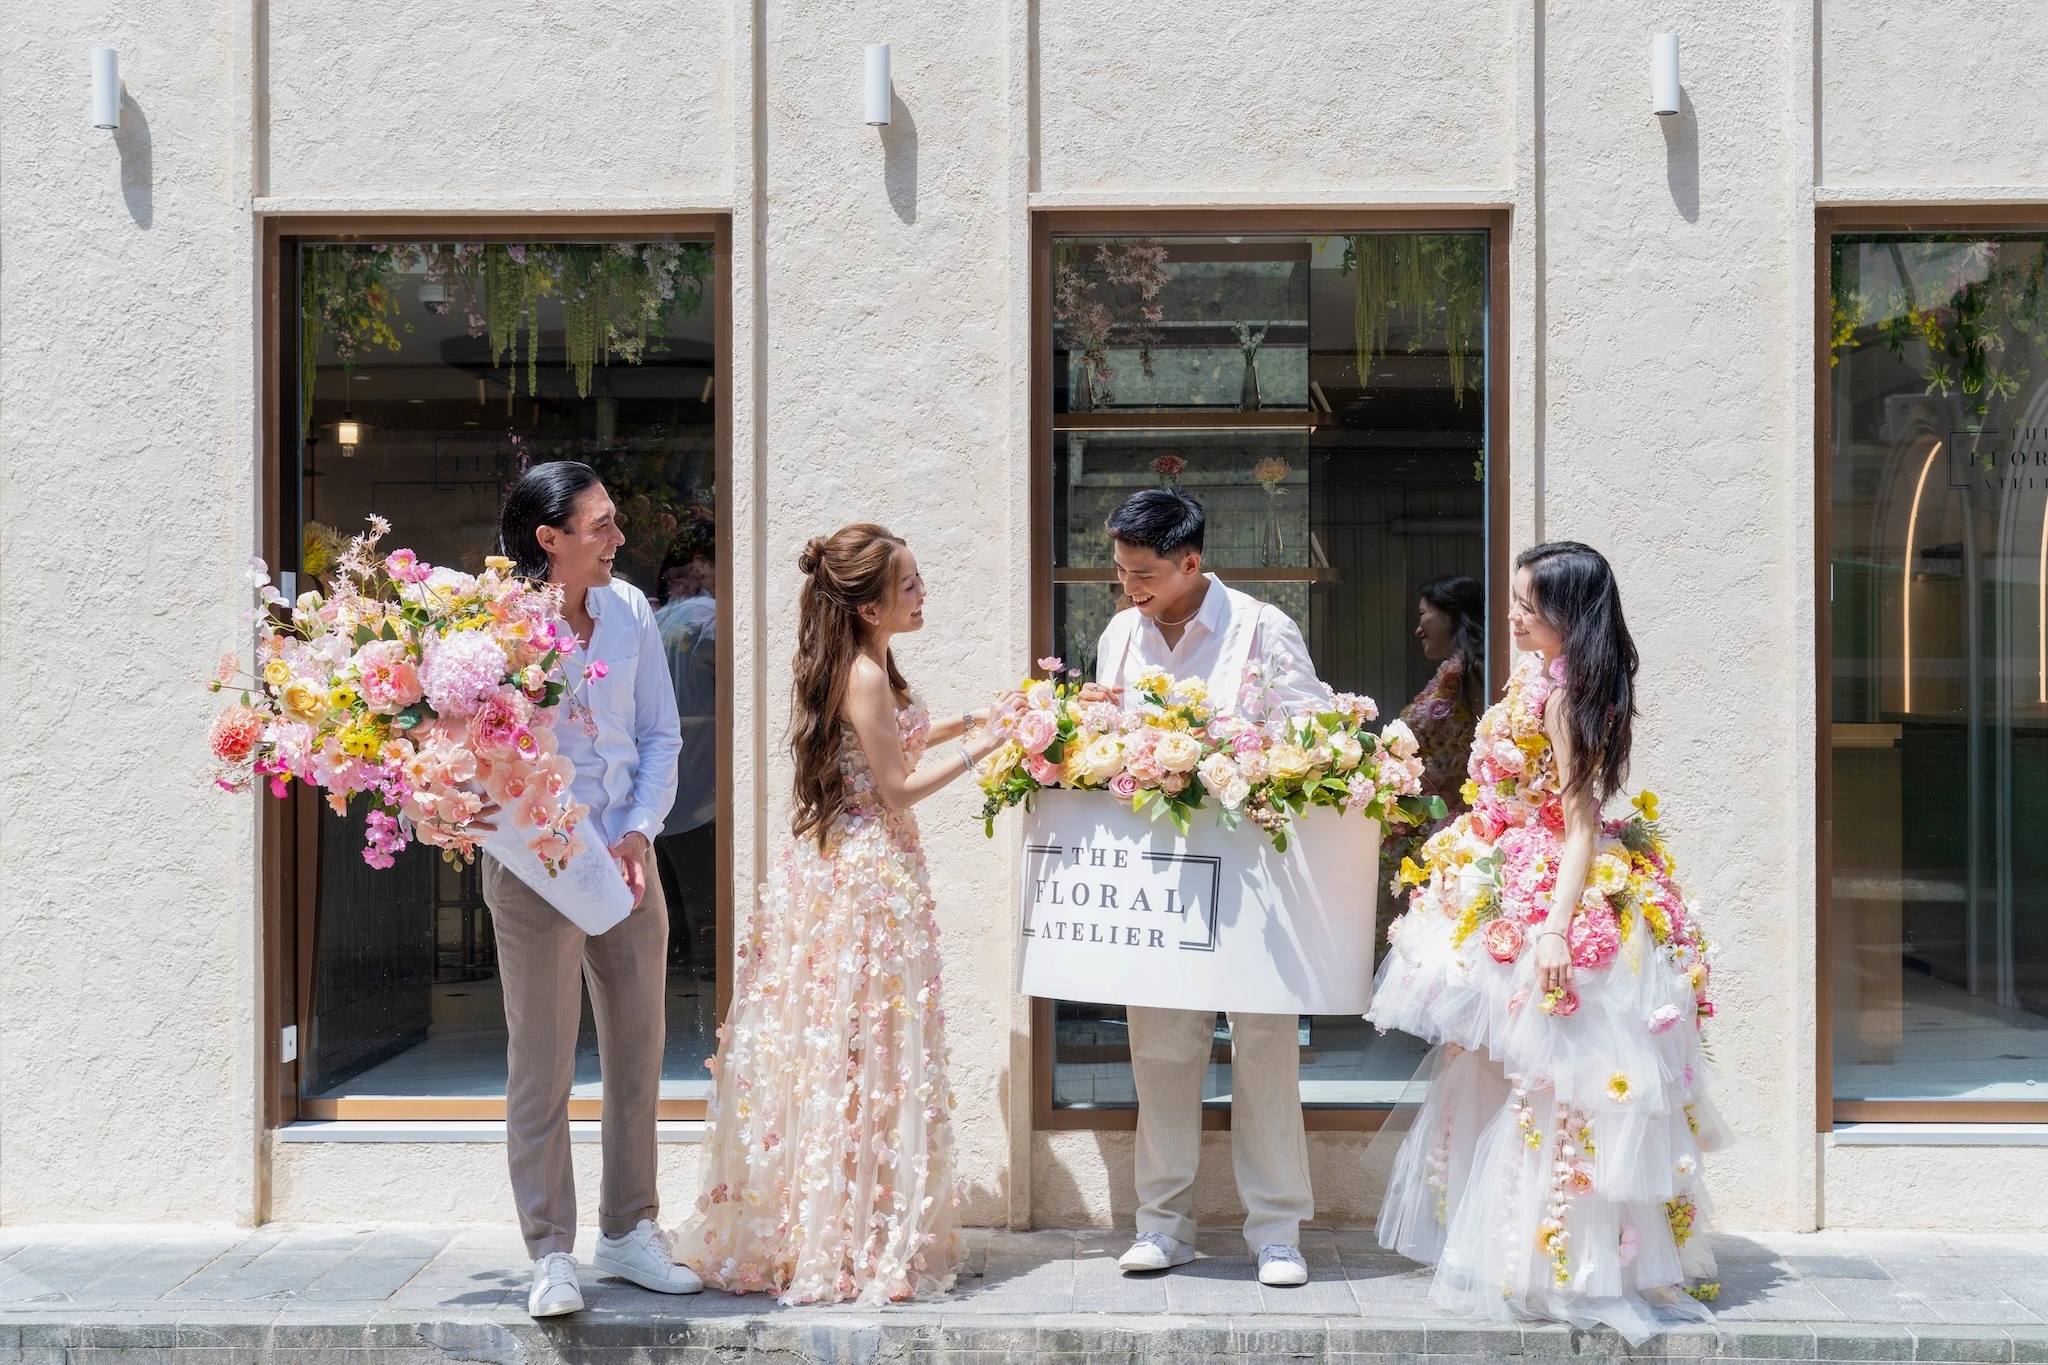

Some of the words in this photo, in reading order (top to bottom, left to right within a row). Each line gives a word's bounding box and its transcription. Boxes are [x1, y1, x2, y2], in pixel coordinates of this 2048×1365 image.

[1071, 847, 1128, 868] THE
[1035, 879, 1185, 914] FLORAL
[1041, 921, 1166, 948] ATELIER
